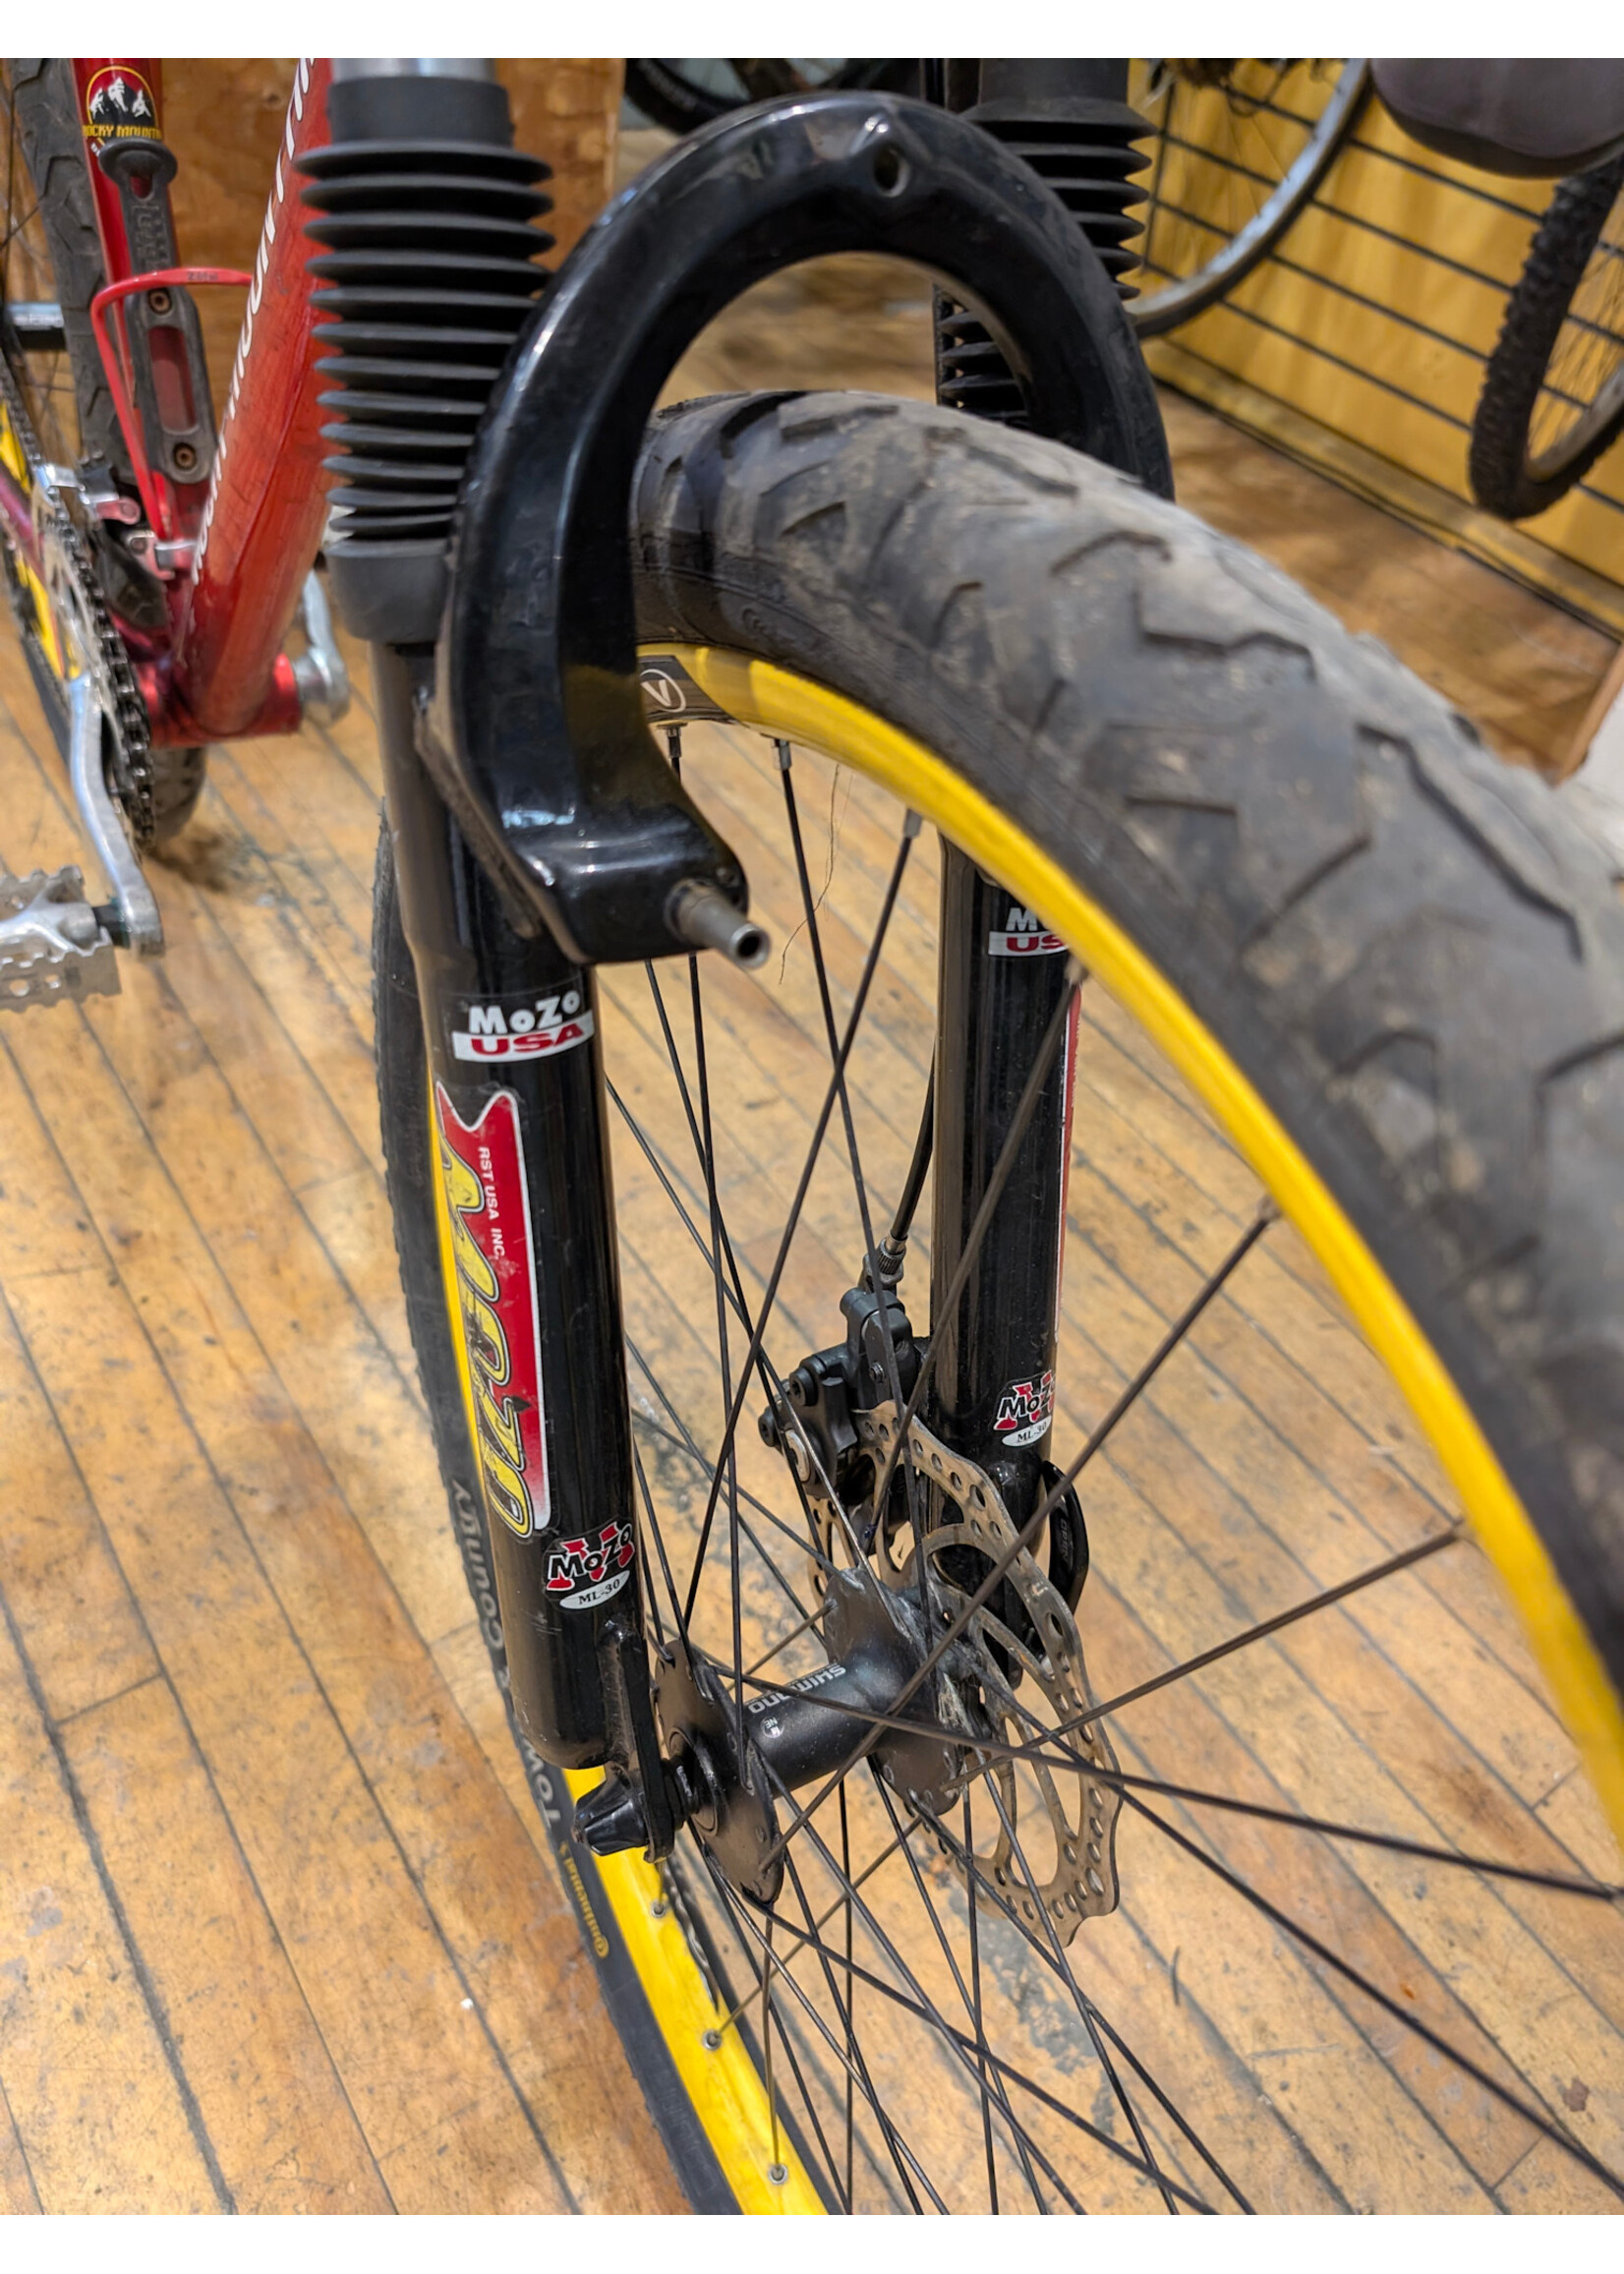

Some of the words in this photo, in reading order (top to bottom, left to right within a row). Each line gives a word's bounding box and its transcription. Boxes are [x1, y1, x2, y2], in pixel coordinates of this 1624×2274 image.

[1006, 934, 1066, 953] US
[471, 1022, 584, 1056] USA
[478, 1145, 494, 1182] RST
[484, 1185, 500, 1220] USA
[490, 1228, 505, 1259] INC.
[578, 1578, 621, 1605] ML-30
